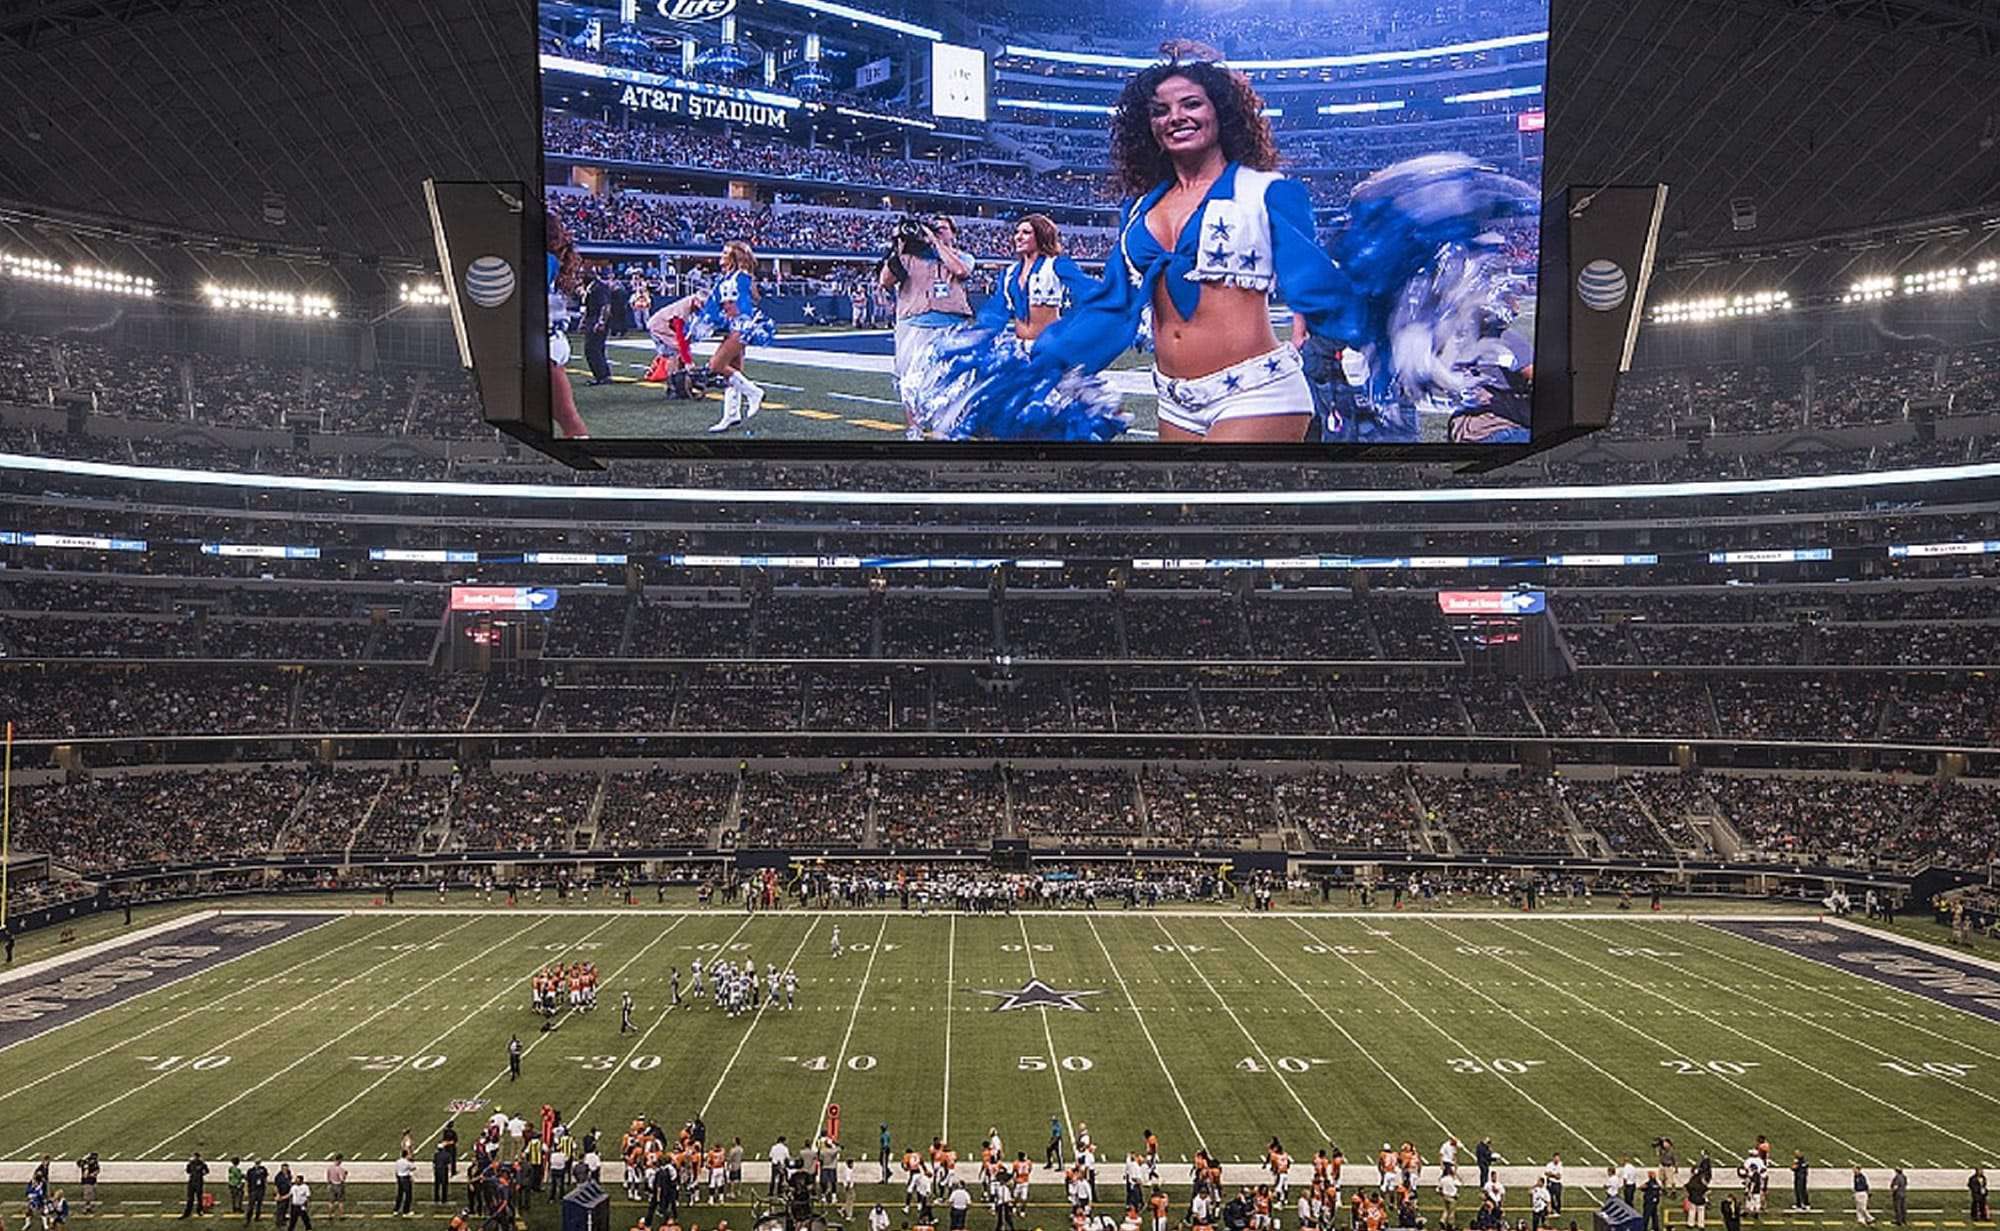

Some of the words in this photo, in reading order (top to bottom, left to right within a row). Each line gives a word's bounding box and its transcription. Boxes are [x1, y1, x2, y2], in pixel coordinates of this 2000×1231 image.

[619, 85, 683, 112] AT&T
[688, 94, 787, 128] STADIUM
[152, 1055, 232, 1070] 10
[360, 1055, 447, 1070] 20
[581, 1055, 661, 1070] 30
[801, 1056, 877, 1070] 40
[1018, 1056, 1093, 1071] 50
[1235, 1056, 1309, 1072] 40
[1446, 1058, 1527, 1073] 30
[1660, 1060, 1747, 1074] 20
[1879, 1062, 1967, 1076] 10
